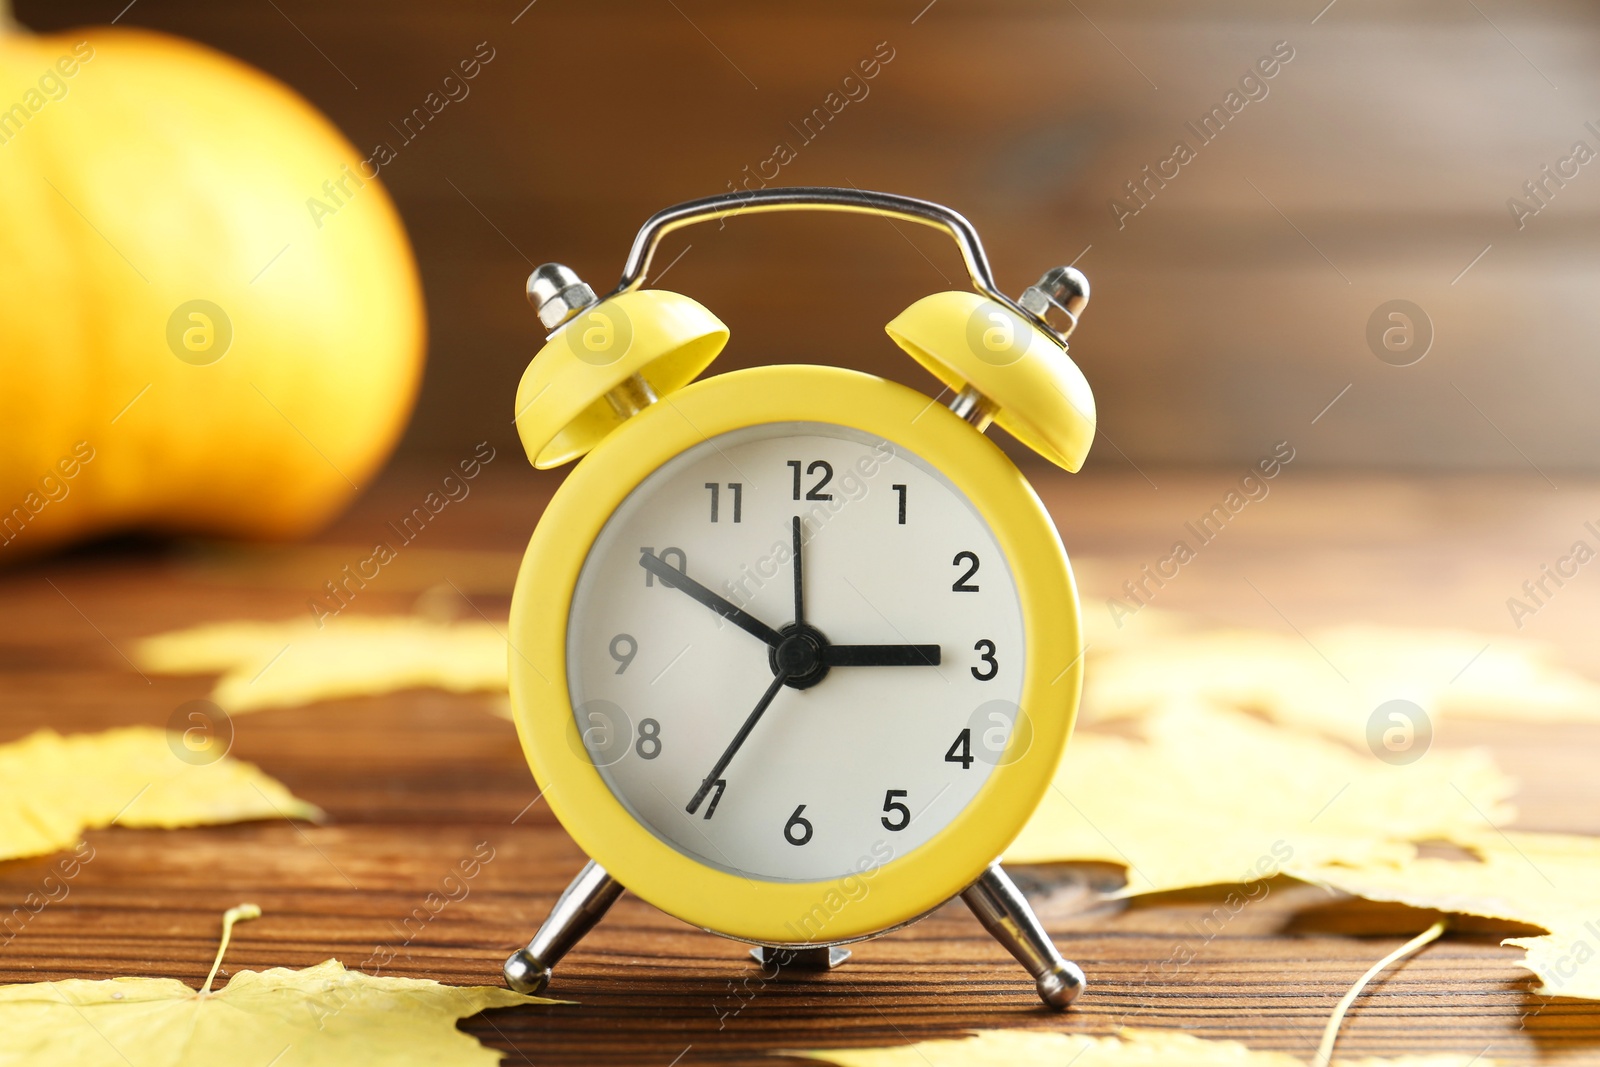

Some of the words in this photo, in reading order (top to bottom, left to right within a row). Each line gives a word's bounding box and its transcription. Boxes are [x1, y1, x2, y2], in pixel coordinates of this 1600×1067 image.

[787, 460, 833, 501] 12
[704, 482, 743, 523] 11
[892, 484, 907, 525] 1
[640, 546, 687, 588] 10
[952, 551, 980, 592] 2
[609, 633, 638, 675] 9
[970, 639, 999, 682] 3
[635, 718, 662, 760] 8
[944, 728, 974, 770] 4
[702, 778, 727, 820] 7
[881, 789, 911, 832] 5
[783, 804, 813, 846] 6
